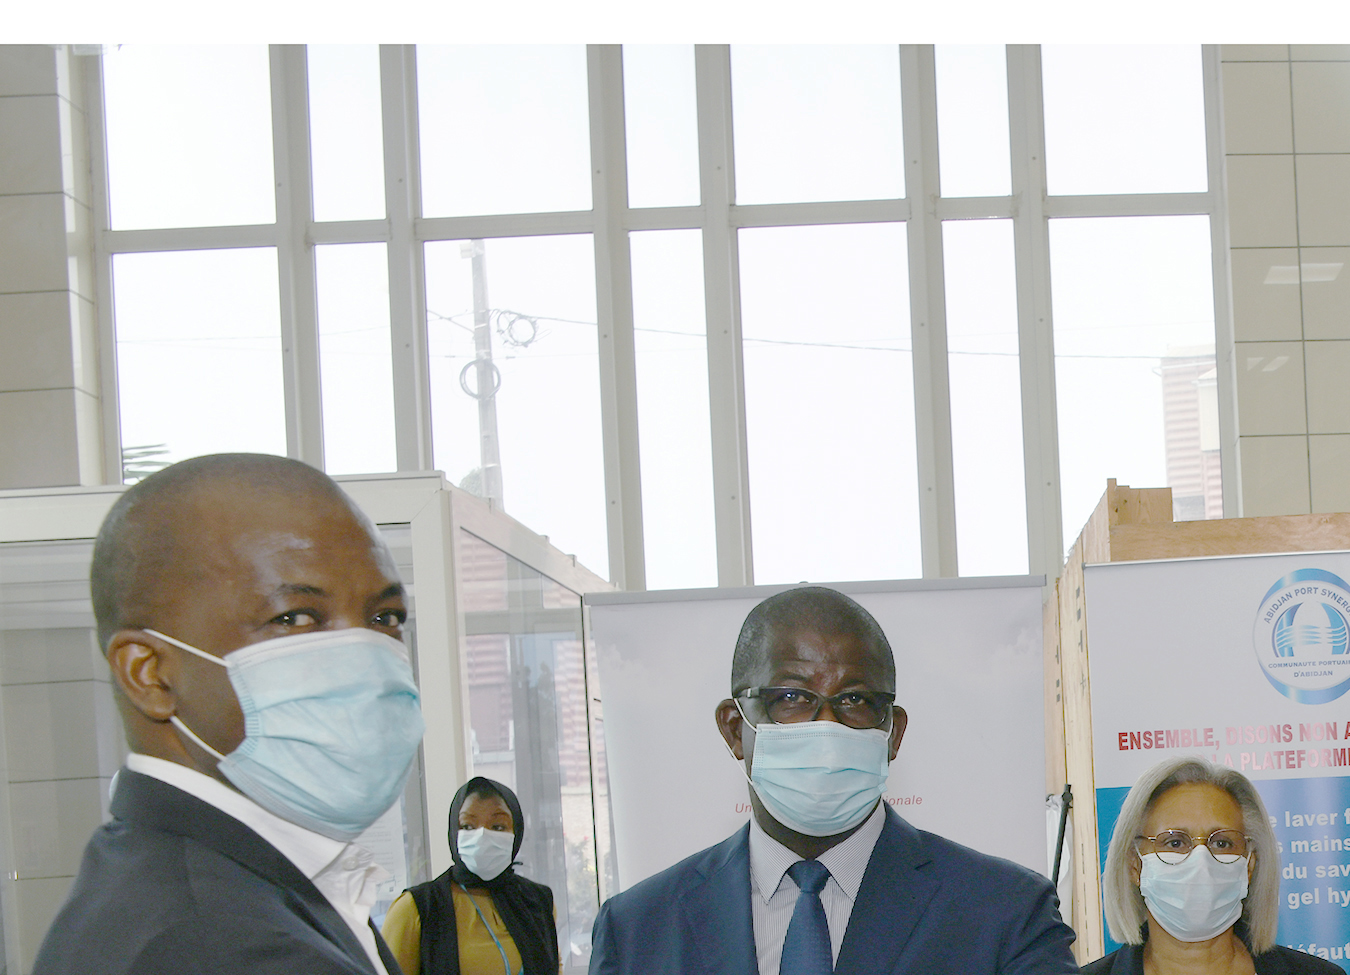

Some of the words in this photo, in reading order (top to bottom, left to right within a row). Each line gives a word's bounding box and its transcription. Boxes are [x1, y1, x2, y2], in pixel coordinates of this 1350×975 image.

[1263, 591, 1293, 624] ABIDJAN
[1294, 586, 1319, 597] PORT
[1268, 661, 1317, 669] COMMUNAUTE
[1293, 670, 1333, 678] D'ABIDJAN
[1118, 728, 1220, 750] ENSEMBLE,
[1226, 724, 1293, 746] DISONS
[1299, 721, 1338, 742] NON
[735, 803, 752, 814] Un
[1284, 810, 1338, 828] laver
[1282, 862, 1308, 880] du
[1287, 888, 1320, 909] gel
